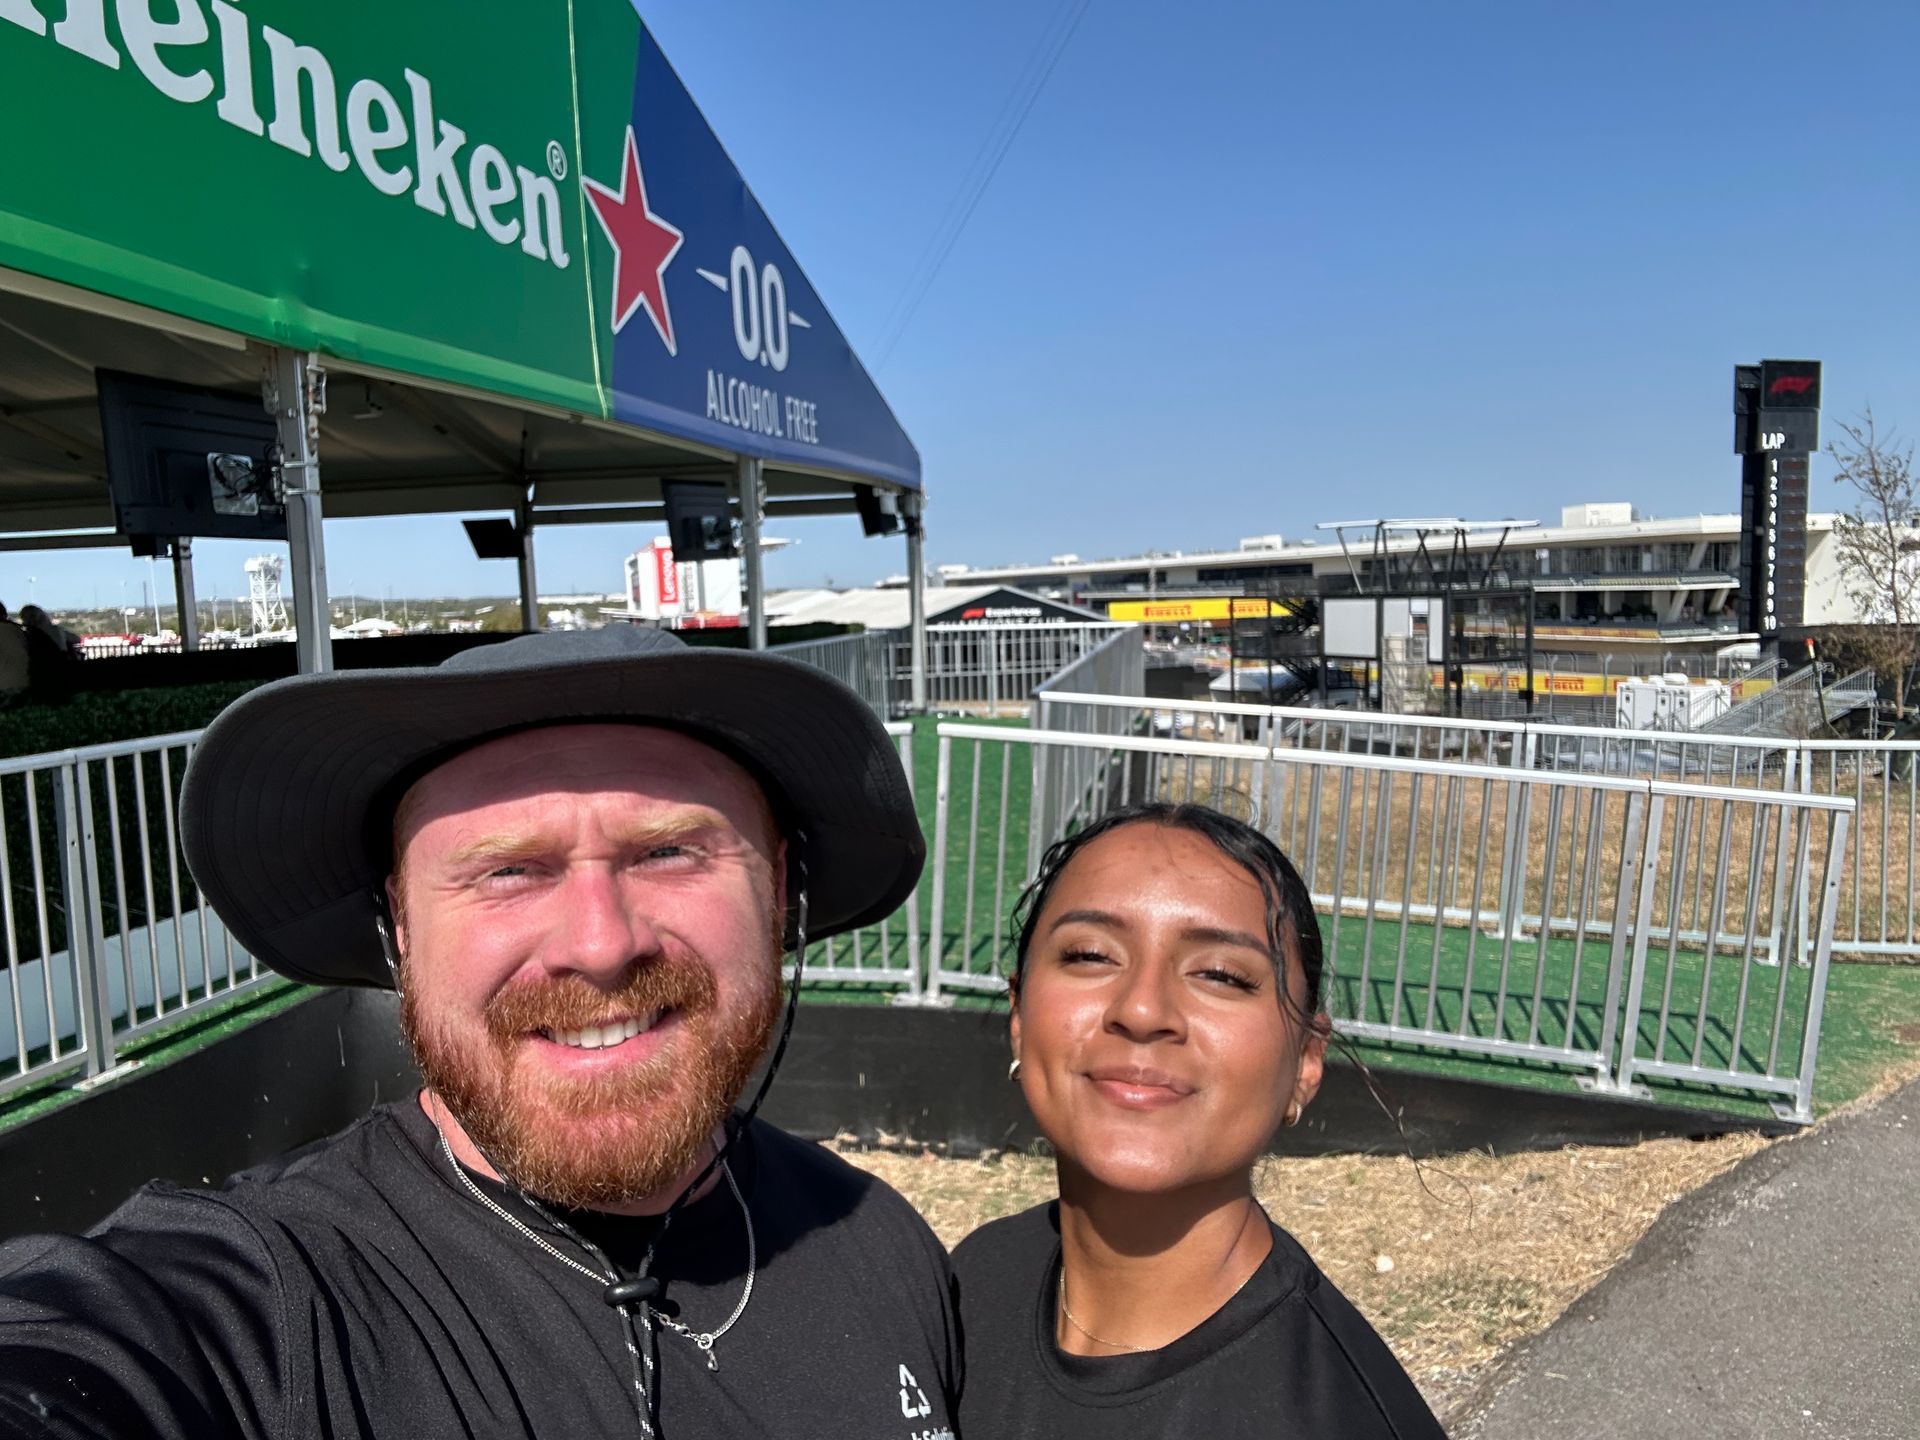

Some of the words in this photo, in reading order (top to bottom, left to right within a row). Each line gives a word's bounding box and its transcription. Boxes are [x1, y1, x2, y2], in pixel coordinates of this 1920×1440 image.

[706, 369, 783, 437] ALCOHOL
[785, 395, 819, 444] FREE
[1762, 432, 1786, 449] LAP
[1771, 459, 1778, 473] 1
[1770, 476, 1778, 490] 2
[1770, 493, 1777, 508] 3
[1769, 511, 1776, 526] 4
[1769, 528, 1776, 543] 5
[1768, 546, 1776, 560] 6
[662, 551, 675, 601] Lenovo
[1768, 564, 1775, 578] 7
[1767, 581, 1775, 596] 8
[1767, 598, 1774, 613] 9
[1764, 615, 1776, 630] 10
[1544, 676, 1584, 691] PRELLI
